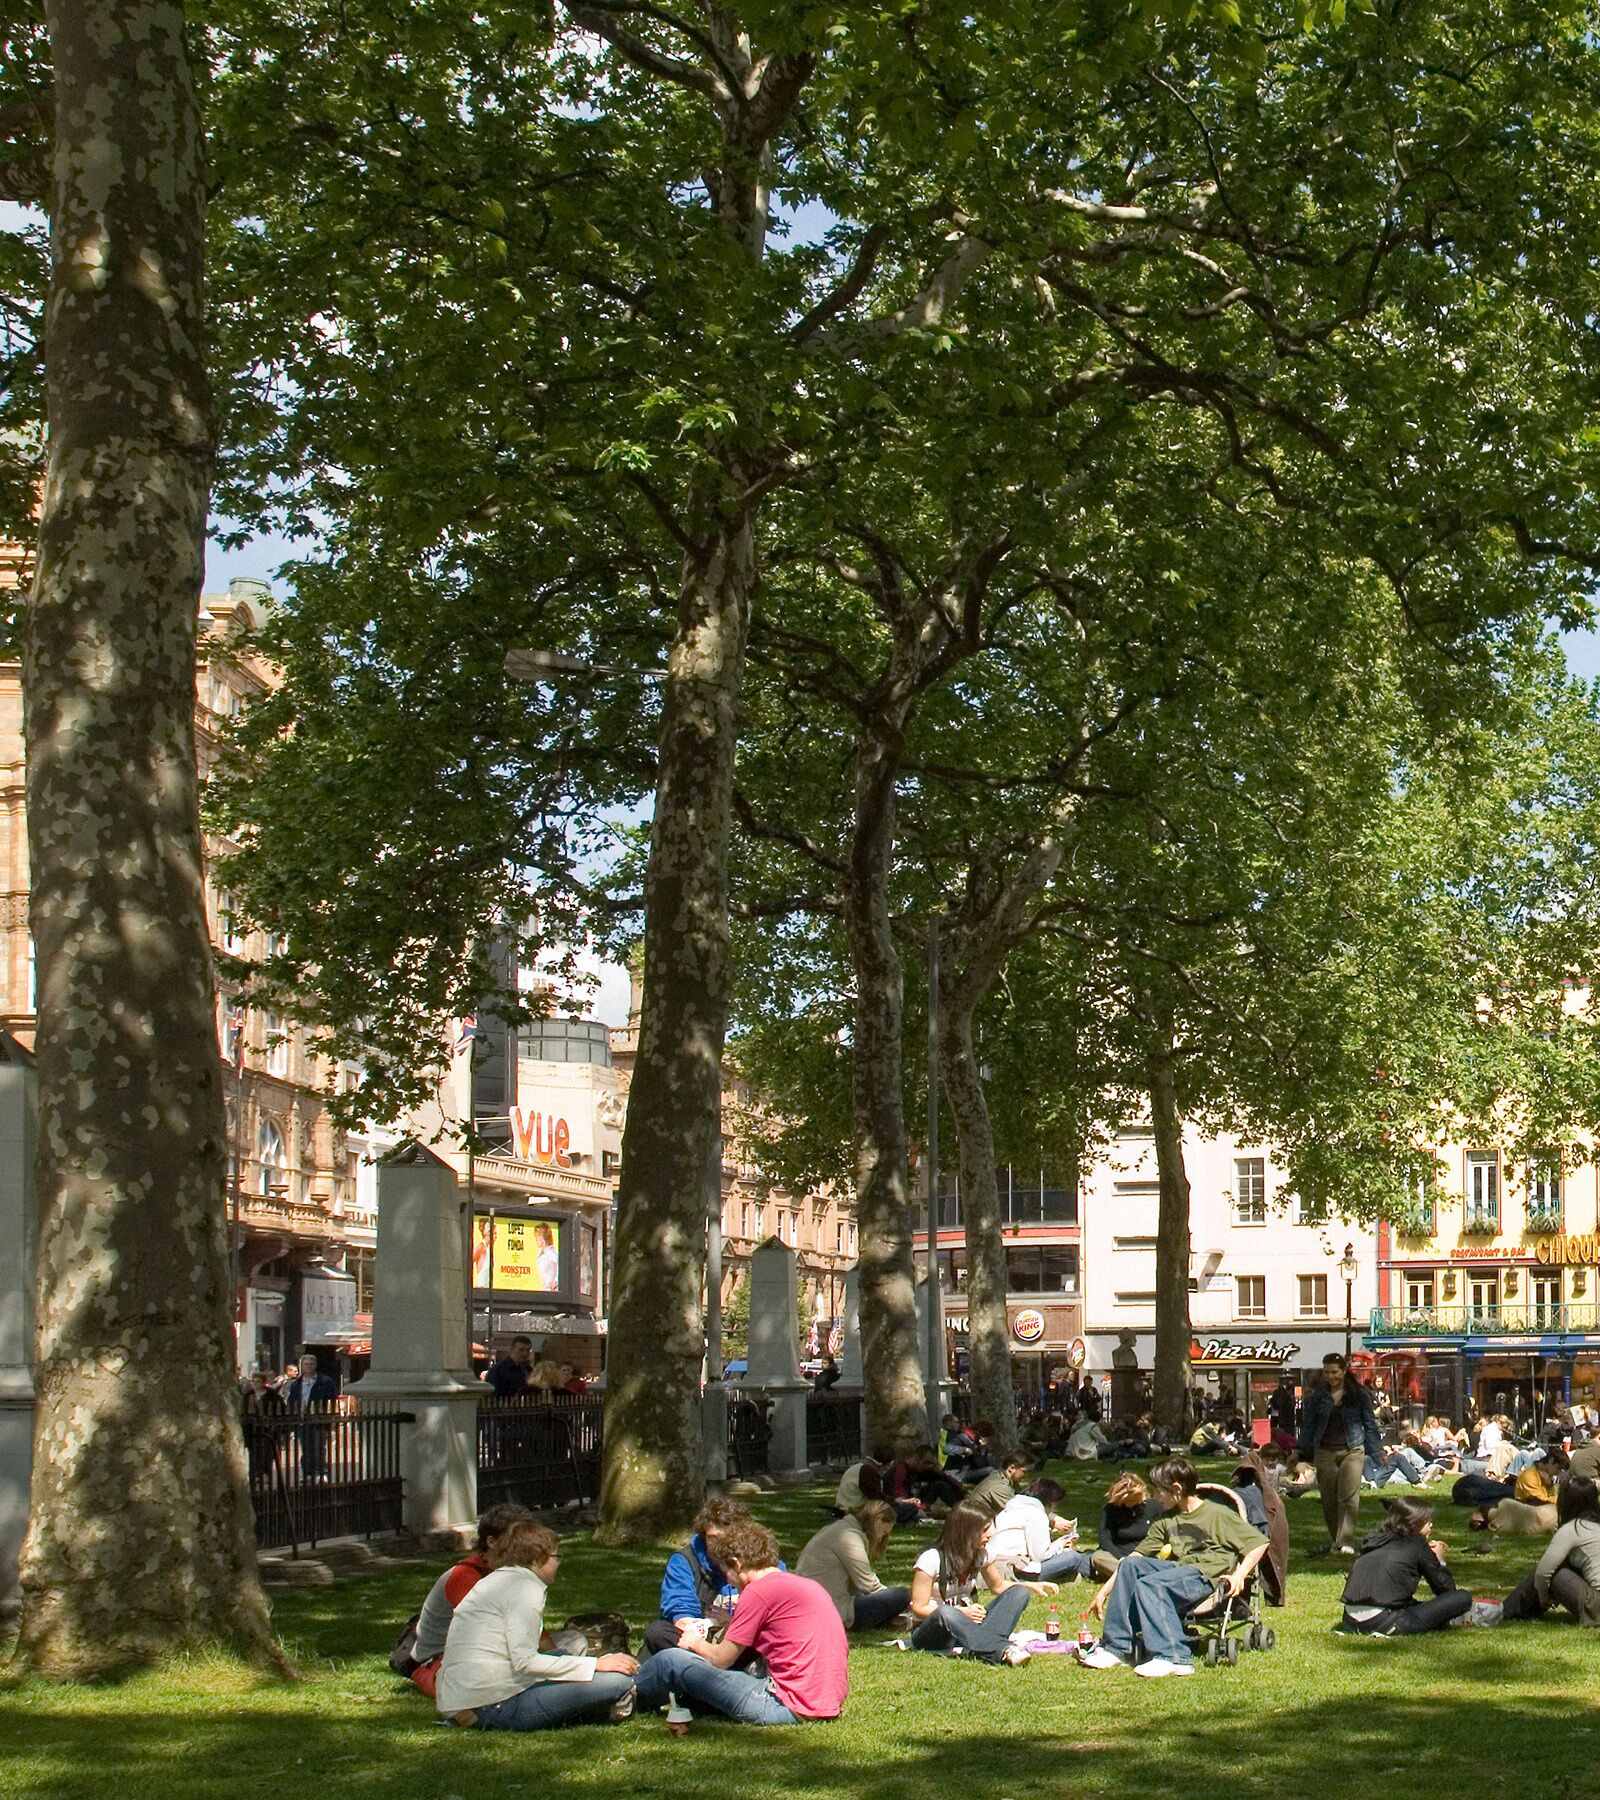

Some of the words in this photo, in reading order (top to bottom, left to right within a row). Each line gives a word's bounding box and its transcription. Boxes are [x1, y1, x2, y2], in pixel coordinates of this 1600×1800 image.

[501, 1265, 531, 1275] MONSTER
[1018, 1321, 1040, 1333] KING
[1202, 1340, 1253, 1359] Pizza
[1253, 1341, 1299, 1360] Hut
